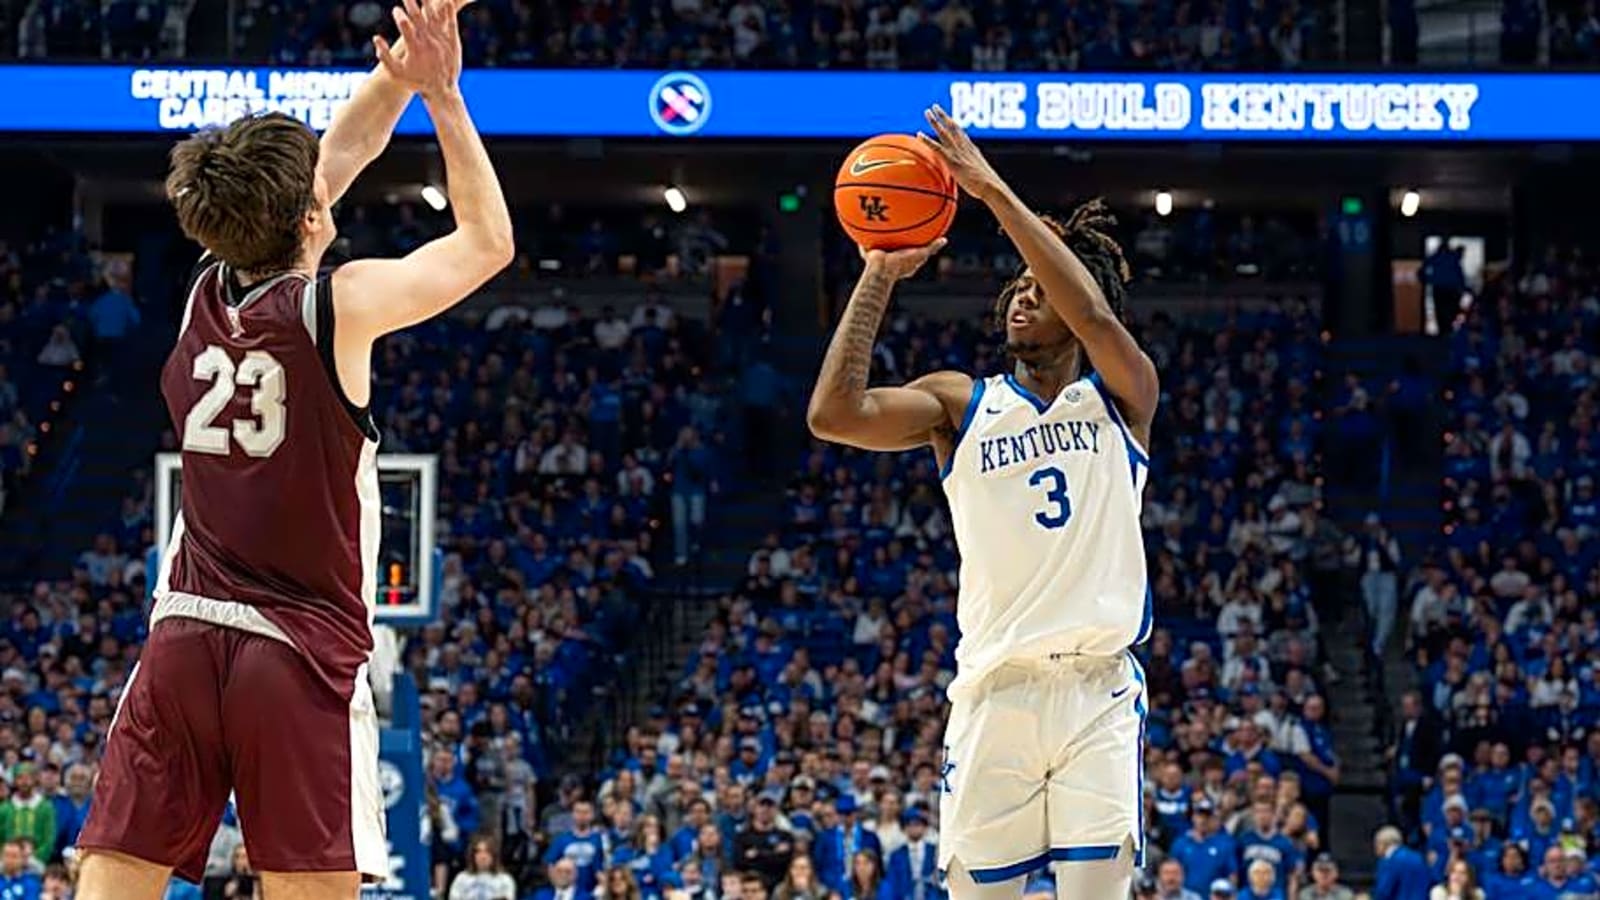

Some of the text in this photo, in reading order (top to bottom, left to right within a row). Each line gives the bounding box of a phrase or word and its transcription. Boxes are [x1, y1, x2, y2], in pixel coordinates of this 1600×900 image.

[132, 71, 263, 98] CENTRAL
[950, 82, 1478, 130] WE BUILD KENTUCKY
[858, 195, 890, 222] UK
[182, 344, 287, 458] 23
[980, 420, 1099, 473] KENTUCKY
[1028, 465, 1072, 530] 3
